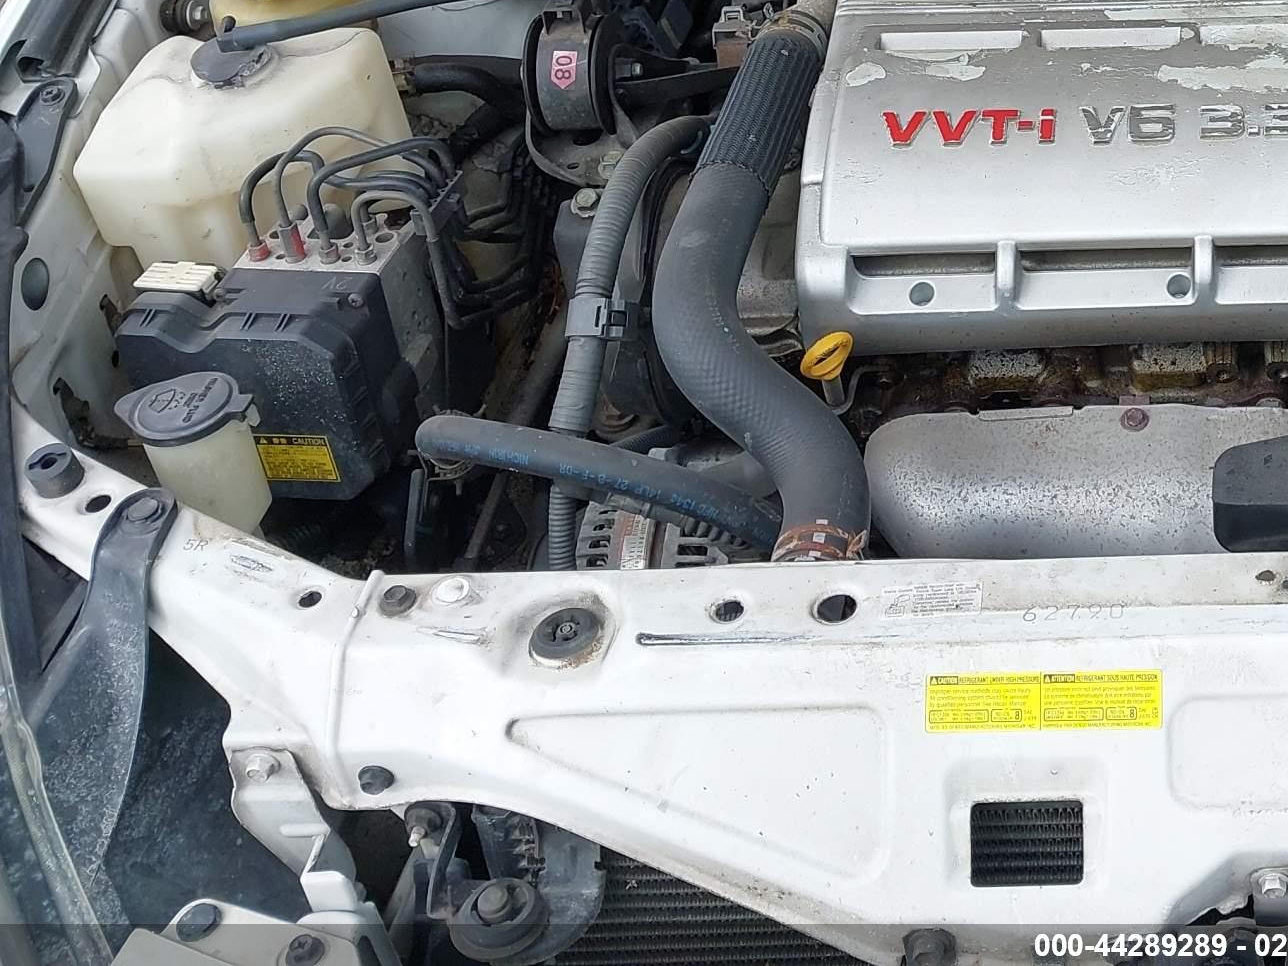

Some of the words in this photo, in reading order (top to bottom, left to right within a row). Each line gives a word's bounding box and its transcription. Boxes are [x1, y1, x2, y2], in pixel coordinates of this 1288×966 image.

[880, 107, 1058, 147] VVT-i
[1078, 103, 1178, 146] V6
[291, 437, 325, 446] CAUTION
[183, 538, 209, 551] 5R
